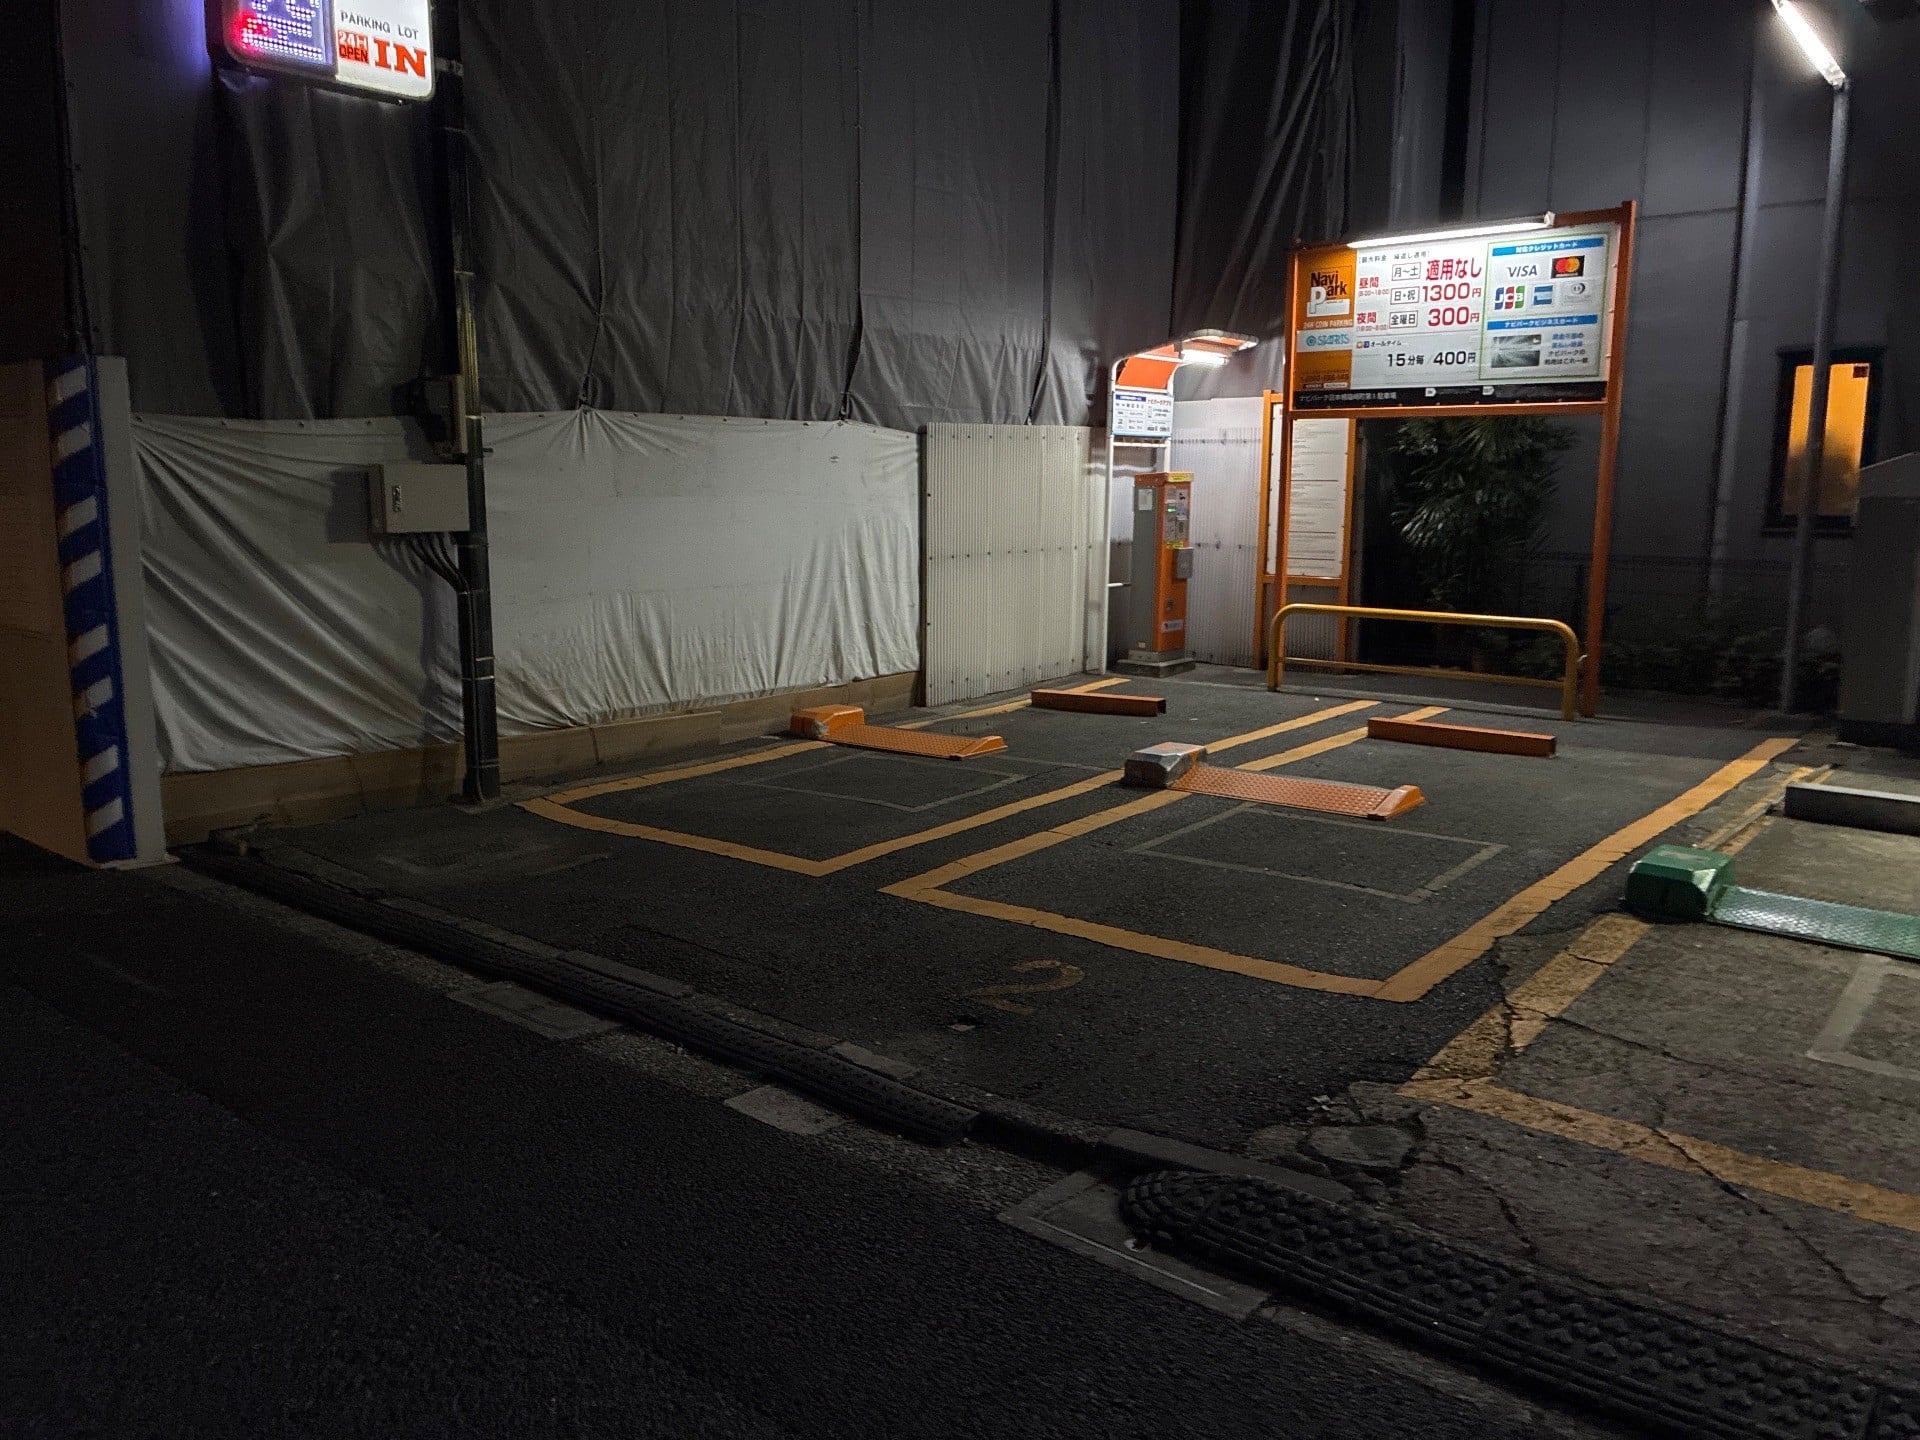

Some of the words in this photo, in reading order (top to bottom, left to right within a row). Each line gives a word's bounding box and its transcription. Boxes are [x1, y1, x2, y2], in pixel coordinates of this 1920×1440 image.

[340, 10, 391, 34] PARKING
[398, 24, 420, 41] LOT
[338, 29, 369, 48] 24H
[338, 43, 370, 64] OPEN
[374, 37, 428, 79] IN
[1310, 270, 1339, 288] Navi
[1425, 257, 1482, 281] 適用なし
[1507, 264, 1538, 278] VISA
[1359, 276, 1380, 289] 昼間
[1308, 281, 1348, 315] Park
[1494, 285, 1526, 310] JCB
[1329, 319, 1353, 328] PARKING
[1356, 312, 1377, 325] 夜間
[1391, 313, 1416, 326] 全曜日
[1428, 306, 1480, 327] 300円
[1433, 351, 1476, 365] 400円
[961, 959, 1085, 1016] 2
